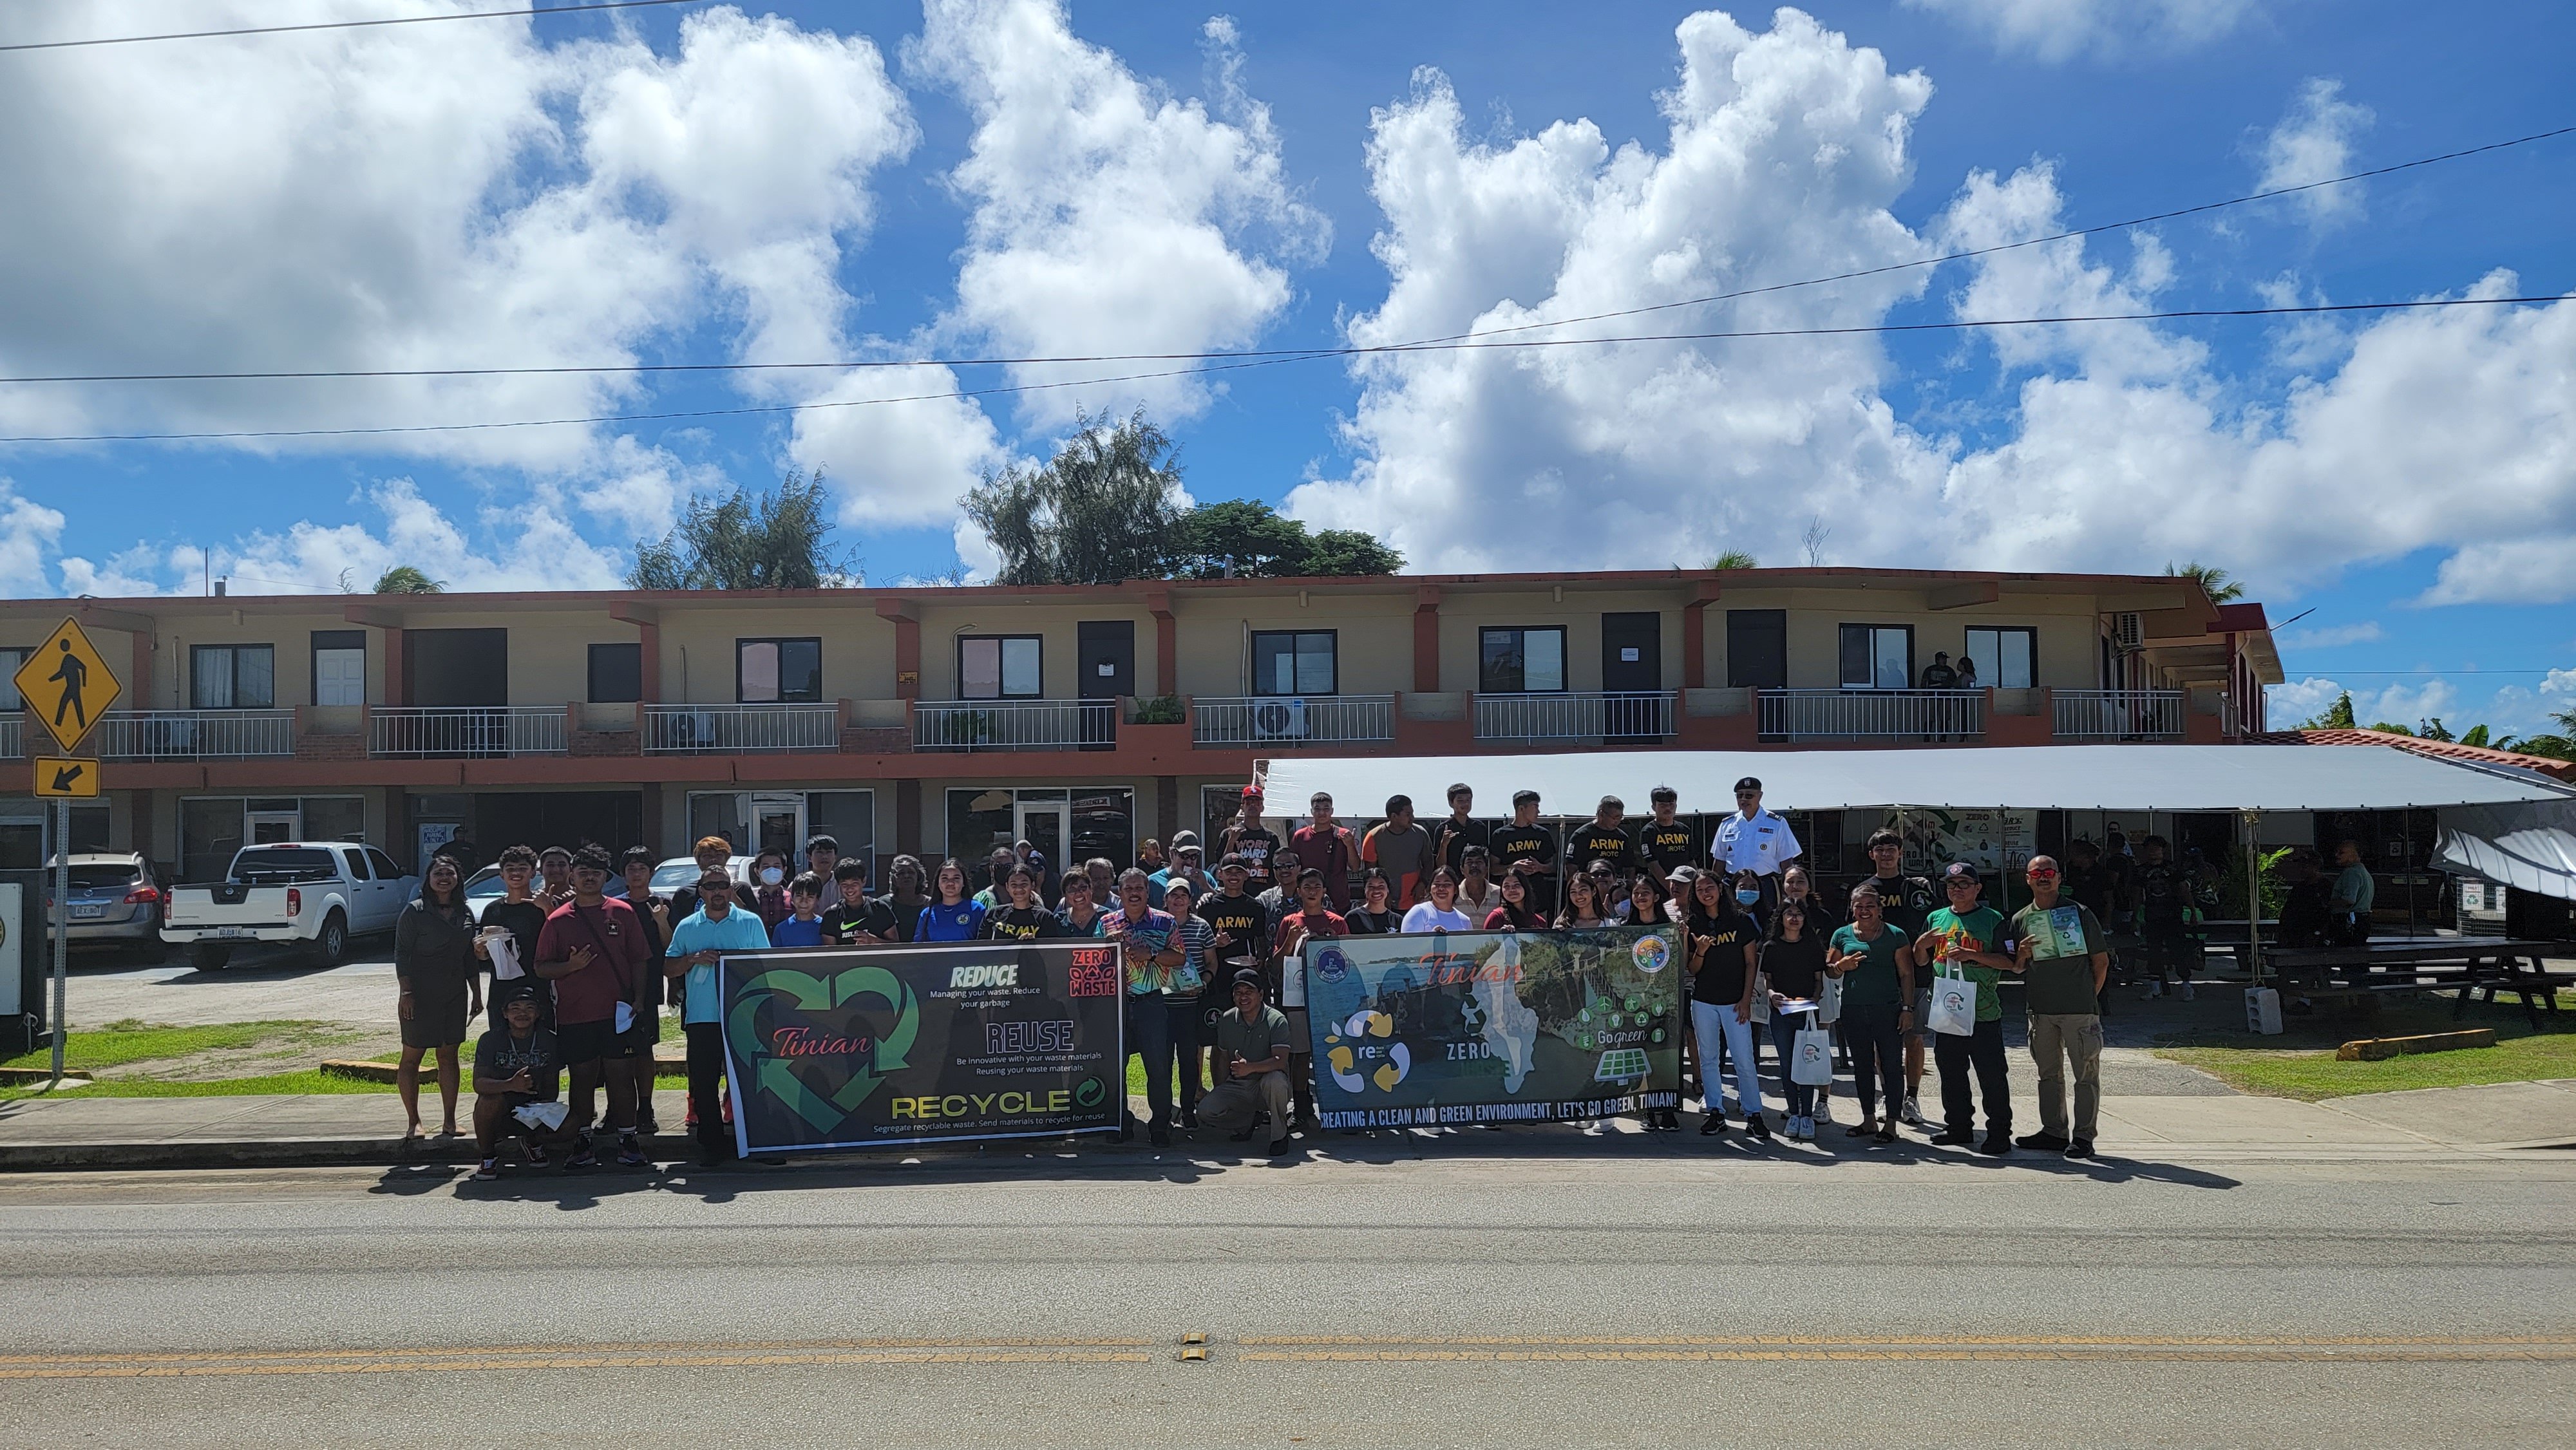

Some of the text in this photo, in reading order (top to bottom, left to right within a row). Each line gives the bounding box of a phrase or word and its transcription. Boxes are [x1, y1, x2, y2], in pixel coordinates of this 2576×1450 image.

[1236, 839, 1271, 849] WORK
[1506, 840, 1542, 853] ARMY
[1589, 838, 1625, 851] ARMY
[1656, 834, 1689, 845] ARMY
[1240, 849, 1268, 858] HARD
[1215, 916, 1254, 928] ARMY
[1072, 950, 1112, 966] ZERO
[1419, 952, 1528, 985] Tinian
[950, 965, 1019, 988] REDUCE
[930, 986, 1041, 999] Managing your waste. Reduce
[1070, 980, 1116, 997] WASTE
[960, 998, 1010, 1010] your garbage
[773, 1027, 873, 1057] Tinian
[986, 1021, 1074, 1054] REUSE
[1598, 1030, 1647, 1048] Go green
[968, 1055, 1007, 1065] innovative
[1009, 1054, 1025, 1062] with
[1026, 1054, 1043, 1064] your
[1045, 1053, 1066, 1061] waste
[1068, 1051, 1103, 1061] materials
[1358, 1046, 1376, 1059] re
[1446, 1042, 1491, 1060] ZERO
[976, 1063, 1084, 1076] Reusing your waste materials
[891, 1089, 1071, 1120] RECYCLE
[1368, 1110, 1376, 1127] A
[1378, 1108, 1412, 1126] CLEAN
[1415, 1107, 1437, 1124] AND
[1439, 1105, 1473, 1123] GREEN
[1476, 1102, 1555, 1121] ENVIRONMENT,
[1557, 1101, 1585, 1119] LET'S
[1587, 1100, 1601, 1116] GO
[1604, 1095, 1636, 1114] GREEN,
[1639, 1092, 1678, 1109] TINIAN!
[873, 1124, 912, 1135] Segregate
[913, 1121, 951, 1131] recyclable
[952, 1120, 977, 1128] waste.
[978, 1118, 998, 1127] Send
[999, 1116, 1034, 1126] materials
[1045, 1115, 1071, 1125] recycle
[1072, 1113, 1084, 1122] for
[1084, 1112, 1105, 1120] reuse
